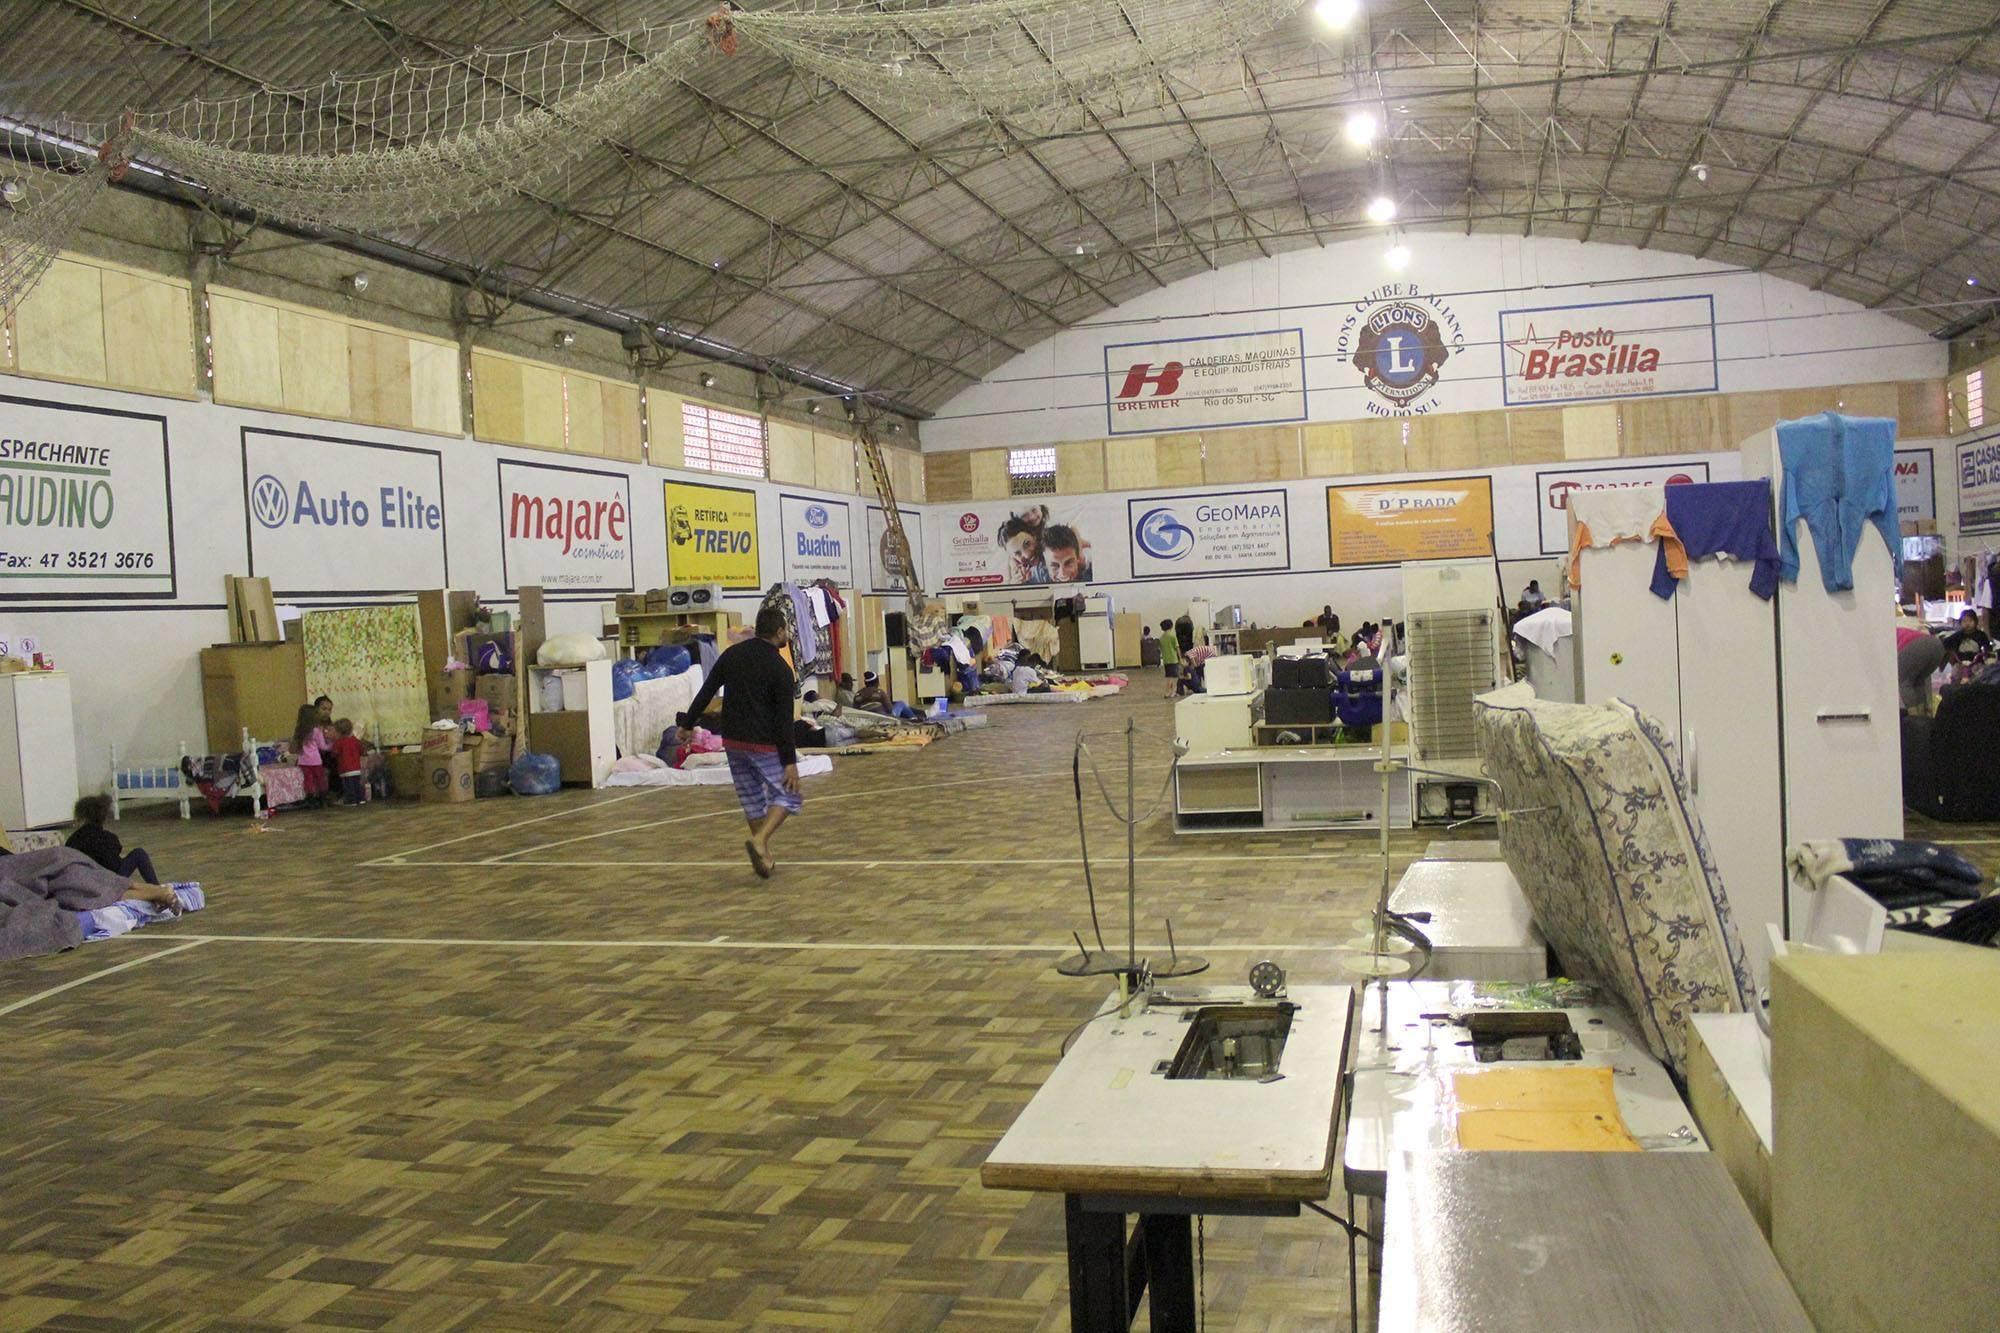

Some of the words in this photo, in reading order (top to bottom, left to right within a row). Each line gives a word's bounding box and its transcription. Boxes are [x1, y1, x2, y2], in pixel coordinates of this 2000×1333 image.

[1337, 314, 1356, 362] LIONS
[1355, 283, 1403, 313] CLUBE
[1373, 308, 1424, 330] LIONS
[1557, 327, 1615, 349] Posto
[1386, 336, 1415, 373] L
[1232, 360, 1290, 374] INDUSTRIAIS
[1117, 399, 1180, 411] BREMER
[1204, 398, 1219, 407] Rio
[1222, 397, 1234, 405] do
[1237, 394, 1252, 404] Sul
[1261, 393, 1275, 402] SC
[1366, 401, 1389, 417] RIO
[1393, 409, 1411, 417] DO
[1415, 398, 1440, 415] SUL
[0, 439, 110, 466] SPACHANTE
[1977, 468, 1988, 486] DA
[293, 481, 369, 527] Auto
[380, 486, 441, 530] Elite
[510, 491, 625, 555] majarê
[694, 529, 752, 554] TREVO
[797, 532, 841, 557] Buatim
[40, 553, 59, 568] 47
[67, 552, 107, 568] 3521
[114, 552, 154, 568] 3676
[975, 560, 986, 568] 24
